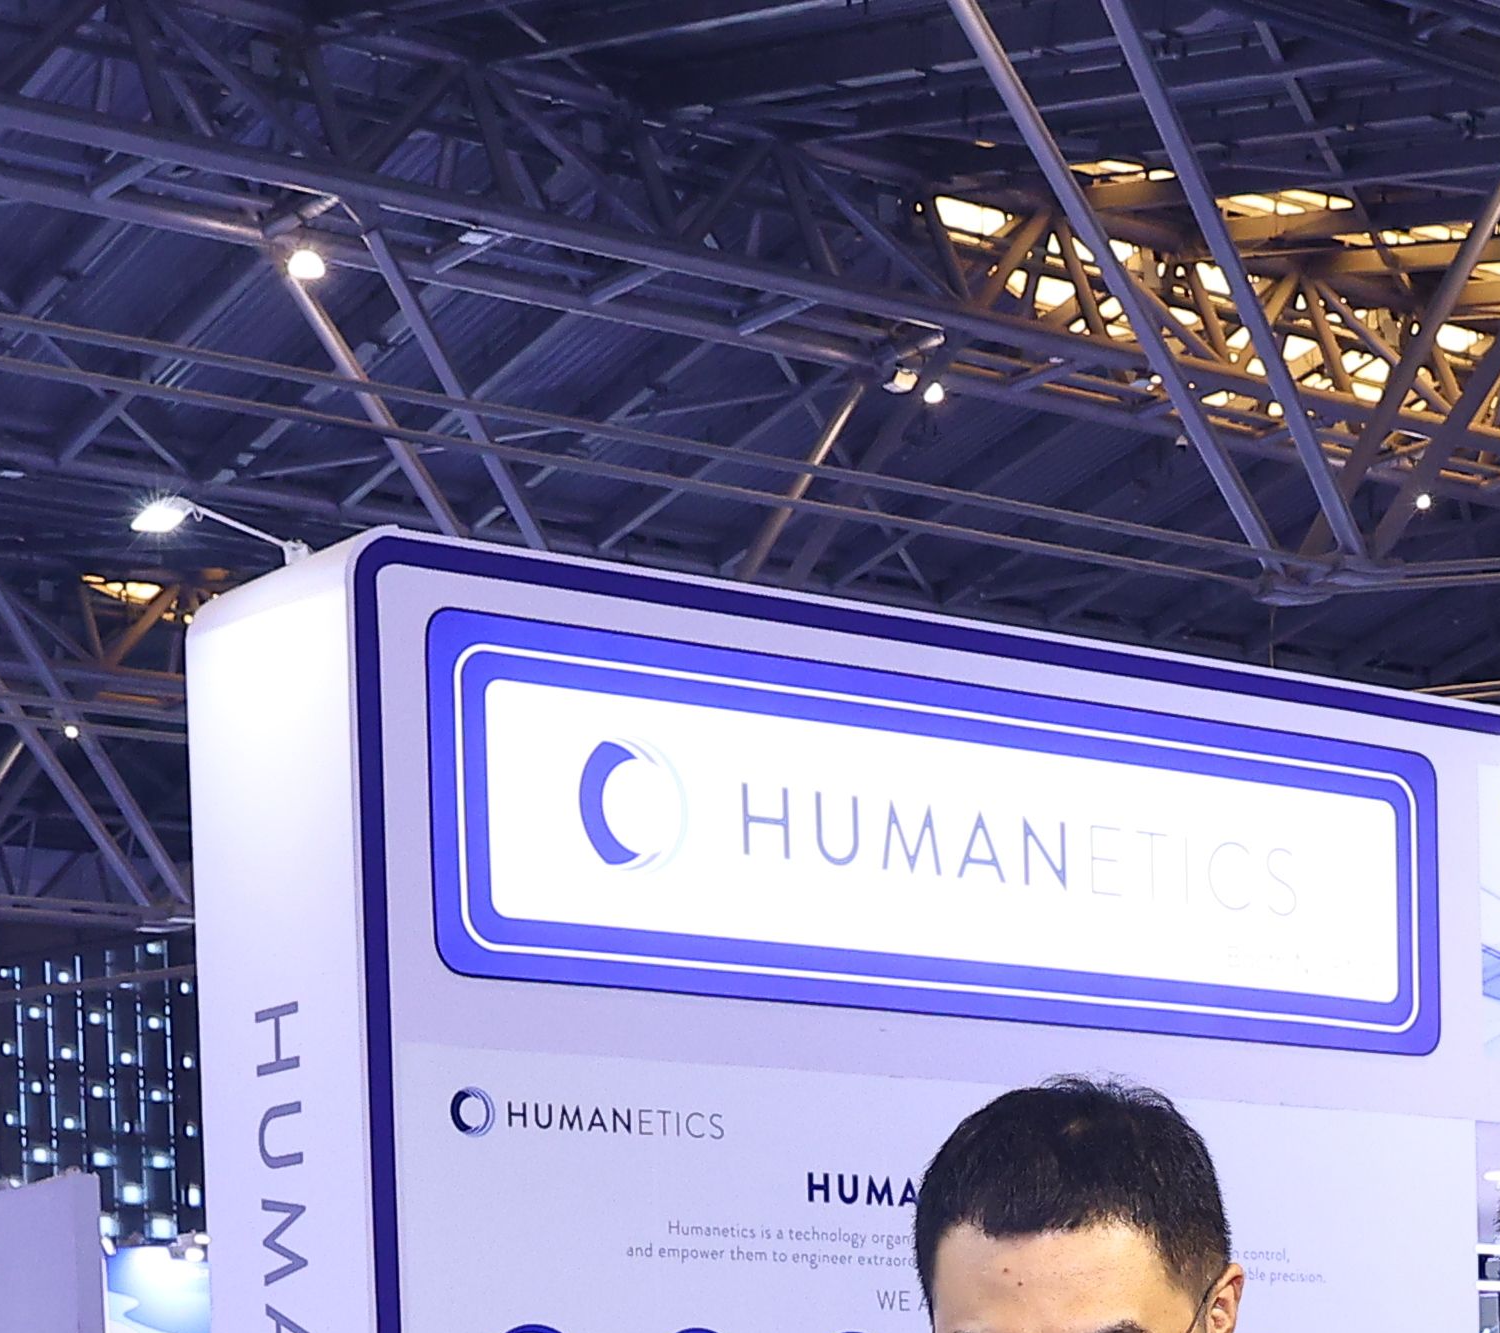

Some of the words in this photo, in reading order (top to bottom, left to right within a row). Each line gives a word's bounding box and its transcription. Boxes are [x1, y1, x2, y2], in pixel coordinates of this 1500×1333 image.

[740, 781, 1298, 918] HUMANETICS
[506, 1101, 725, 1140] HUMANETICS
[807, 1171, 919, 1207] HUMA
[667, 1220, 756, 1240] Humanetics
[761, 1225, 772, 1240] is
[776, 1230, 784, 1241] a
[788, 1227, 866, 1248] technology
[871, 1233, 915, 1250] organ
[626, 1244, 653, 1258] and
[658, 1247, 724, 1263] empower
[730, 1247, 767, 1262] them
[772, 1250, 788, 1263] to
[792, 1252, 852, 1269] engineer
[857, 1253, 917, 1268] extraor
[876, 1290, 910, 1311] WE
